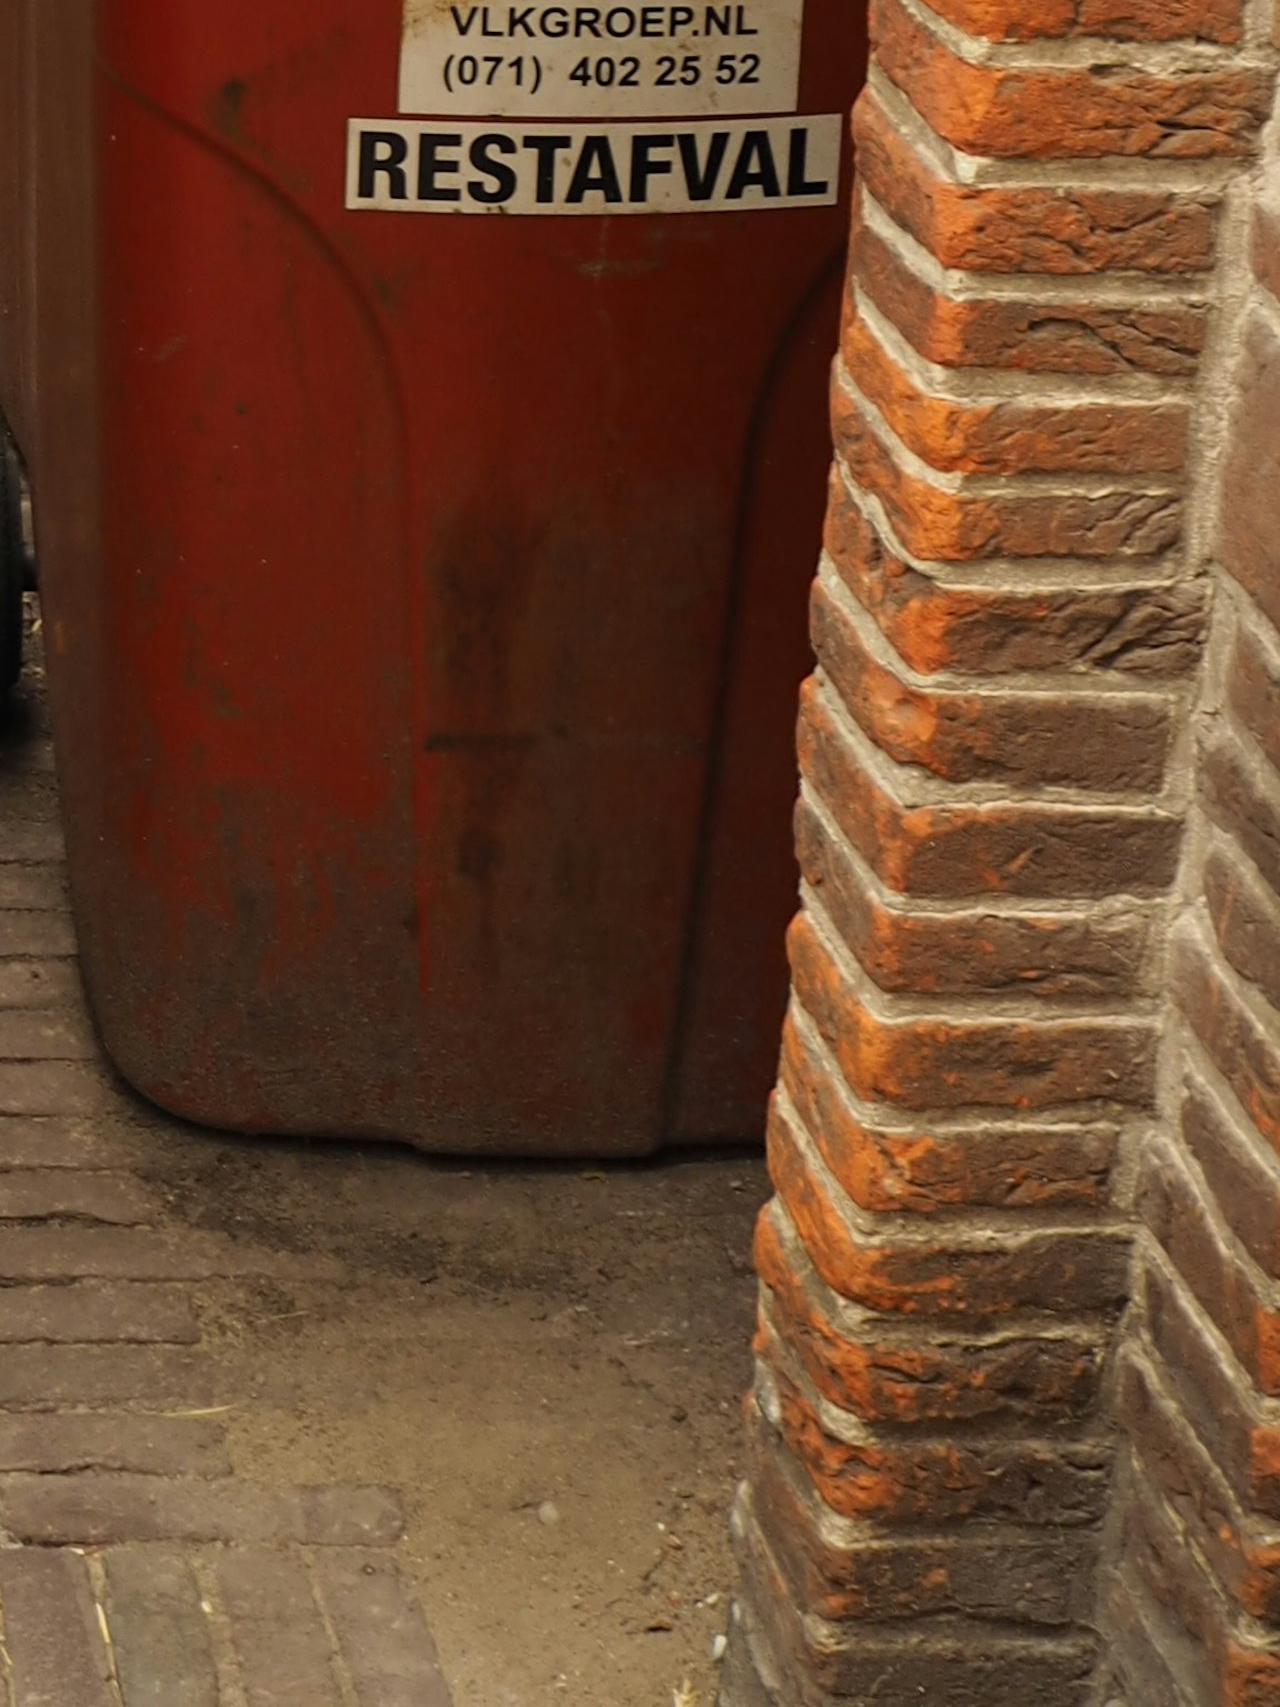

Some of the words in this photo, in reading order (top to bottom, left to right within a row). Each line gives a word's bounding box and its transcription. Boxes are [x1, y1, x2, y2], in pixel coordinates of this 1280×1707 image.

[451, 5, 758, 37] VLKGROEP.NL
[443, 55, 543, 93] (071)
[569, 56, 640, 87] 402
[655, 56, 701, 86] 25
[715, 53, 760, 84] 52
[357, 127, 828, 204] RESTAFVAL
